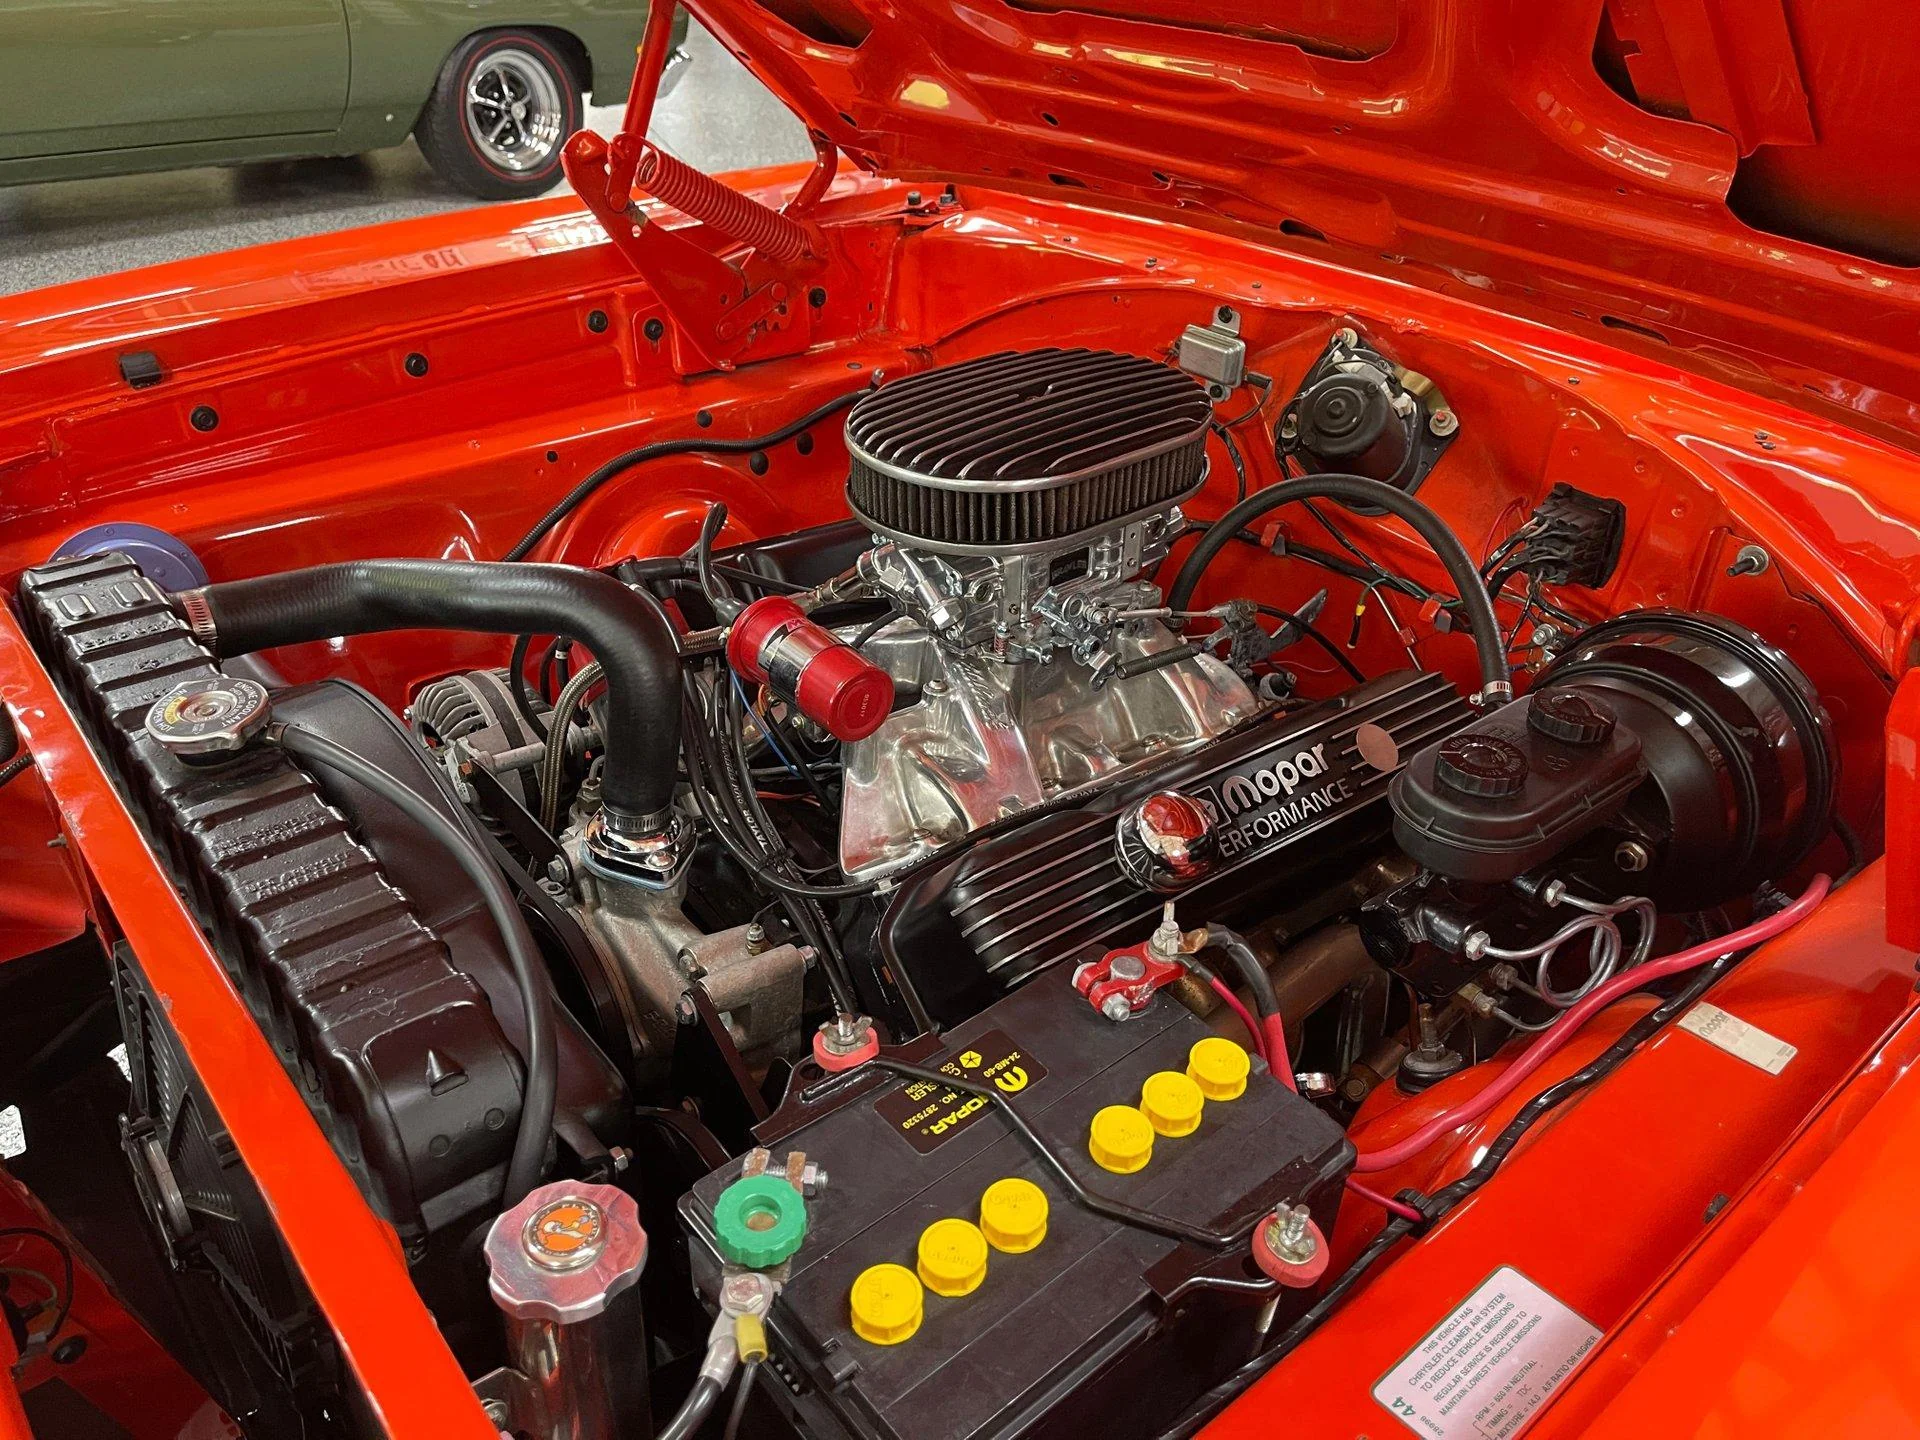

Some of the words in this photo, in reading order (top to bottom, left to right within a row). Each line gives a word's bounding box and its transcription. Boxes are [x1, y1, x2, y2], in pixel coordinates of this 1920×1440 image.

[743, 809, 768, 849] TAYLOR
[1219, 778, 1353, 858] ERFORMANCE
[902, 1103, 939, 1129] 2875320
[1408, 1351, 1444, 1387] CHRYSLER
[1441, 1324, 1472, 1355] CLEANER
[1469, 1314, 1483, 1327] AIR
[1480, 1291, 1506, 1317] SYSTEM
[1420, 1380, 1433, 1393] TO
[1430, 1355, 1458, 1384] REDUCE
[1455, 1331, 1483, 1359] VEHICLE
[1481, 1300, 1515, 1334] EMISSIONS
[1422, 1339, 1438, 1355] THIS
[1435, 1317, 1461, 1343] VEHICLE
[1458, 1305, 1473, 1320] HAS
[1433, 1373, 1462, 1403] REGULAR
[1459, 1350, 1486, 1377] SERVICE
[1483, 1344, 1492, 1353] IS
[1489, 1317, 1519, 1347] REQUIRED
[1516, 1310, 1527, 1321] TO
[1438, 1386, 1468, 1416] MAINTAIN
[1465, 1363, 1492, 1390] LOWEST
[1488, 1341, 1514, 1367] VEHICLE
[1511, 1313, 1542, 1344] EMISSIONS
[1391, 1397, 1416, 1416] 44
[1474, 1405, 1491, 1421] RPM
[1503, 1383, 1512, 1392] IN
[1509, 1358, 1537, 1386] NEUTRAL
[1486, 1407, 1508, 1429] TIMING
[1516, 1383, 1531, 1397] TDC
[1496, 1410, 1525, 1439] MIXTURE
[1550, 1363, 1569, 1382] RATIO
[1566, 1354, 1578, 1366] OR
[1574, 1334, 1597, 1357] HIGHER
